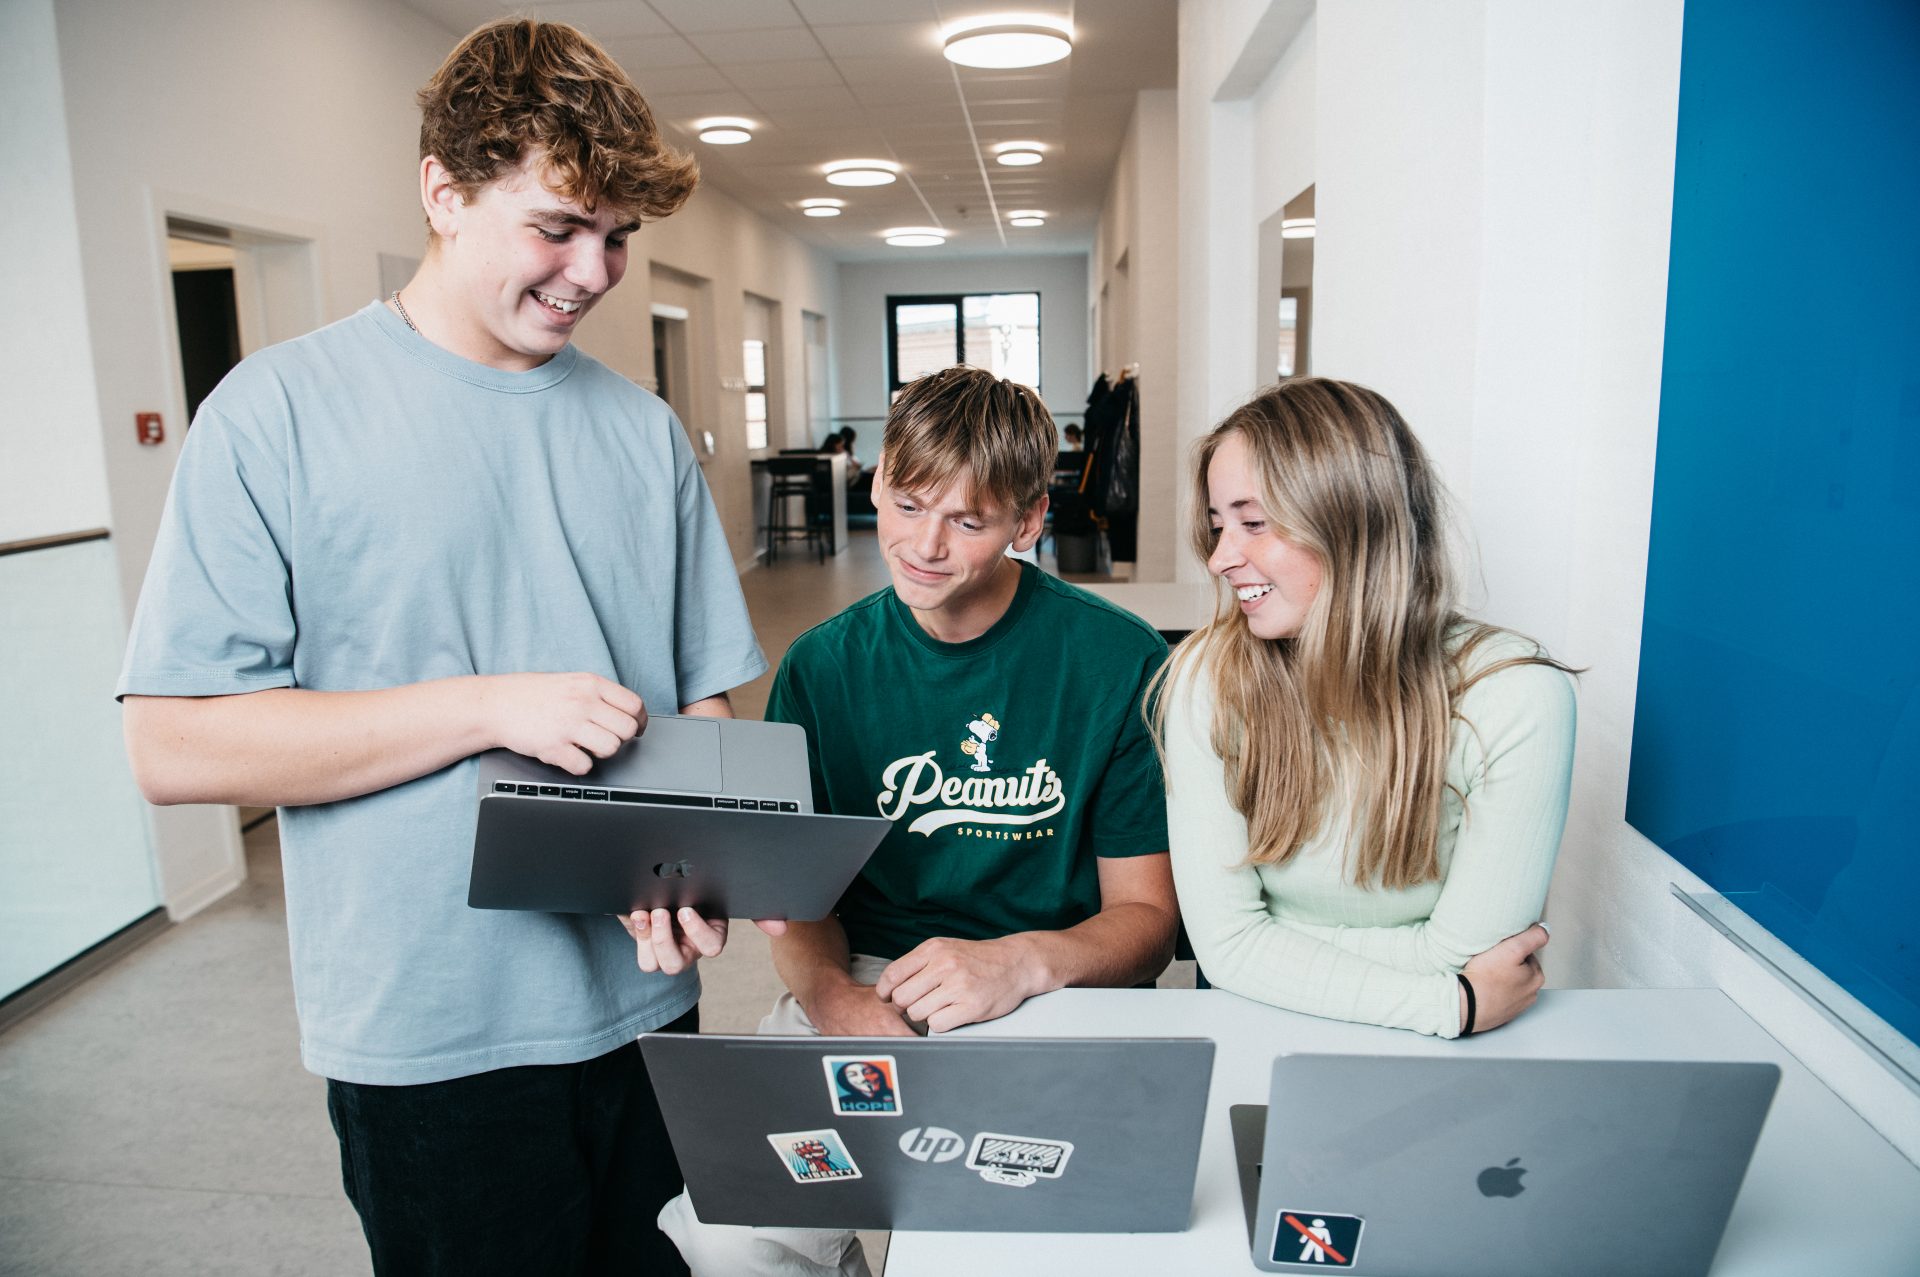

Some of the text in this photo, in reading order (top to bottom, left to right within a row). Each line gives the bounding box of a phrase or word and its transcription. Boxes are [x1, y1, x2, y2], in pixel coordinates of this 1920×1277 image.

[877, 750, 1064, 821] Peanuts
[957, 827, 1054, 841] SPORTSWEAR
[841, 1101, 895, 1112] HOPE
[905, 1127, 961, 1163] hp
[800, 1168, 853, 1180] LIBERTY
